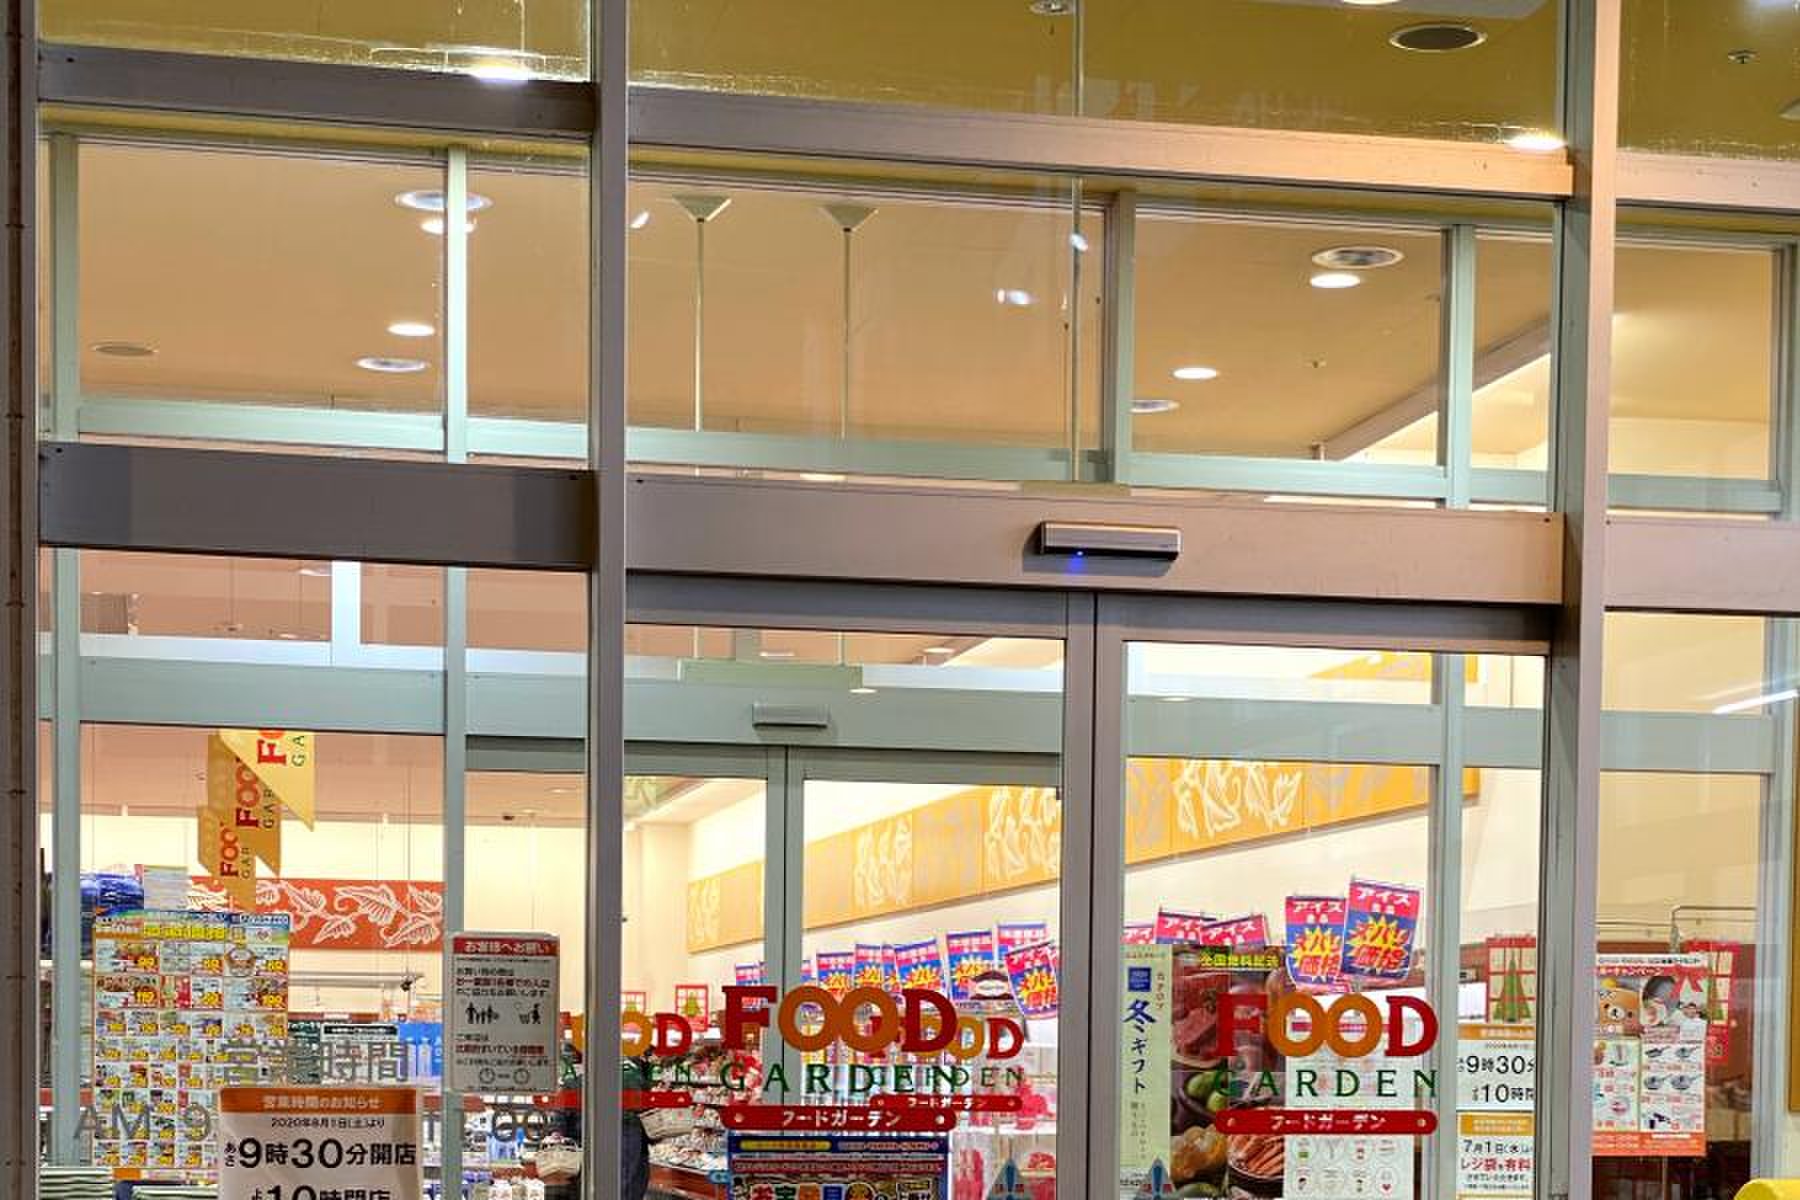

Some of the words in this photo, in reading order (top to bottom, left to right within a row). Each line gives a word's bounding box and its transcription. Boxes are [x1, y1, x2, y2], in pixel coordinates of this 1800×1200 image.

[235, 757, 259, 828] FOO
[1294, 902, 1344, 913] アイス
[1358, 886, 1412, 905] アイス
[722, 985, 957, 1052] FOOD
[1216, 993, 1439, 1058] FOOD
[1123, 998, 1157, 1094] 冬ギフト
[720, 1063, 958, 1093] GARDEN
[1215, 1069, 1438, 1098] GARDEN
[782, 1110, 902, 1128] フードガーデン
[1270, 1114, 1387, 1131] フードガーデン
